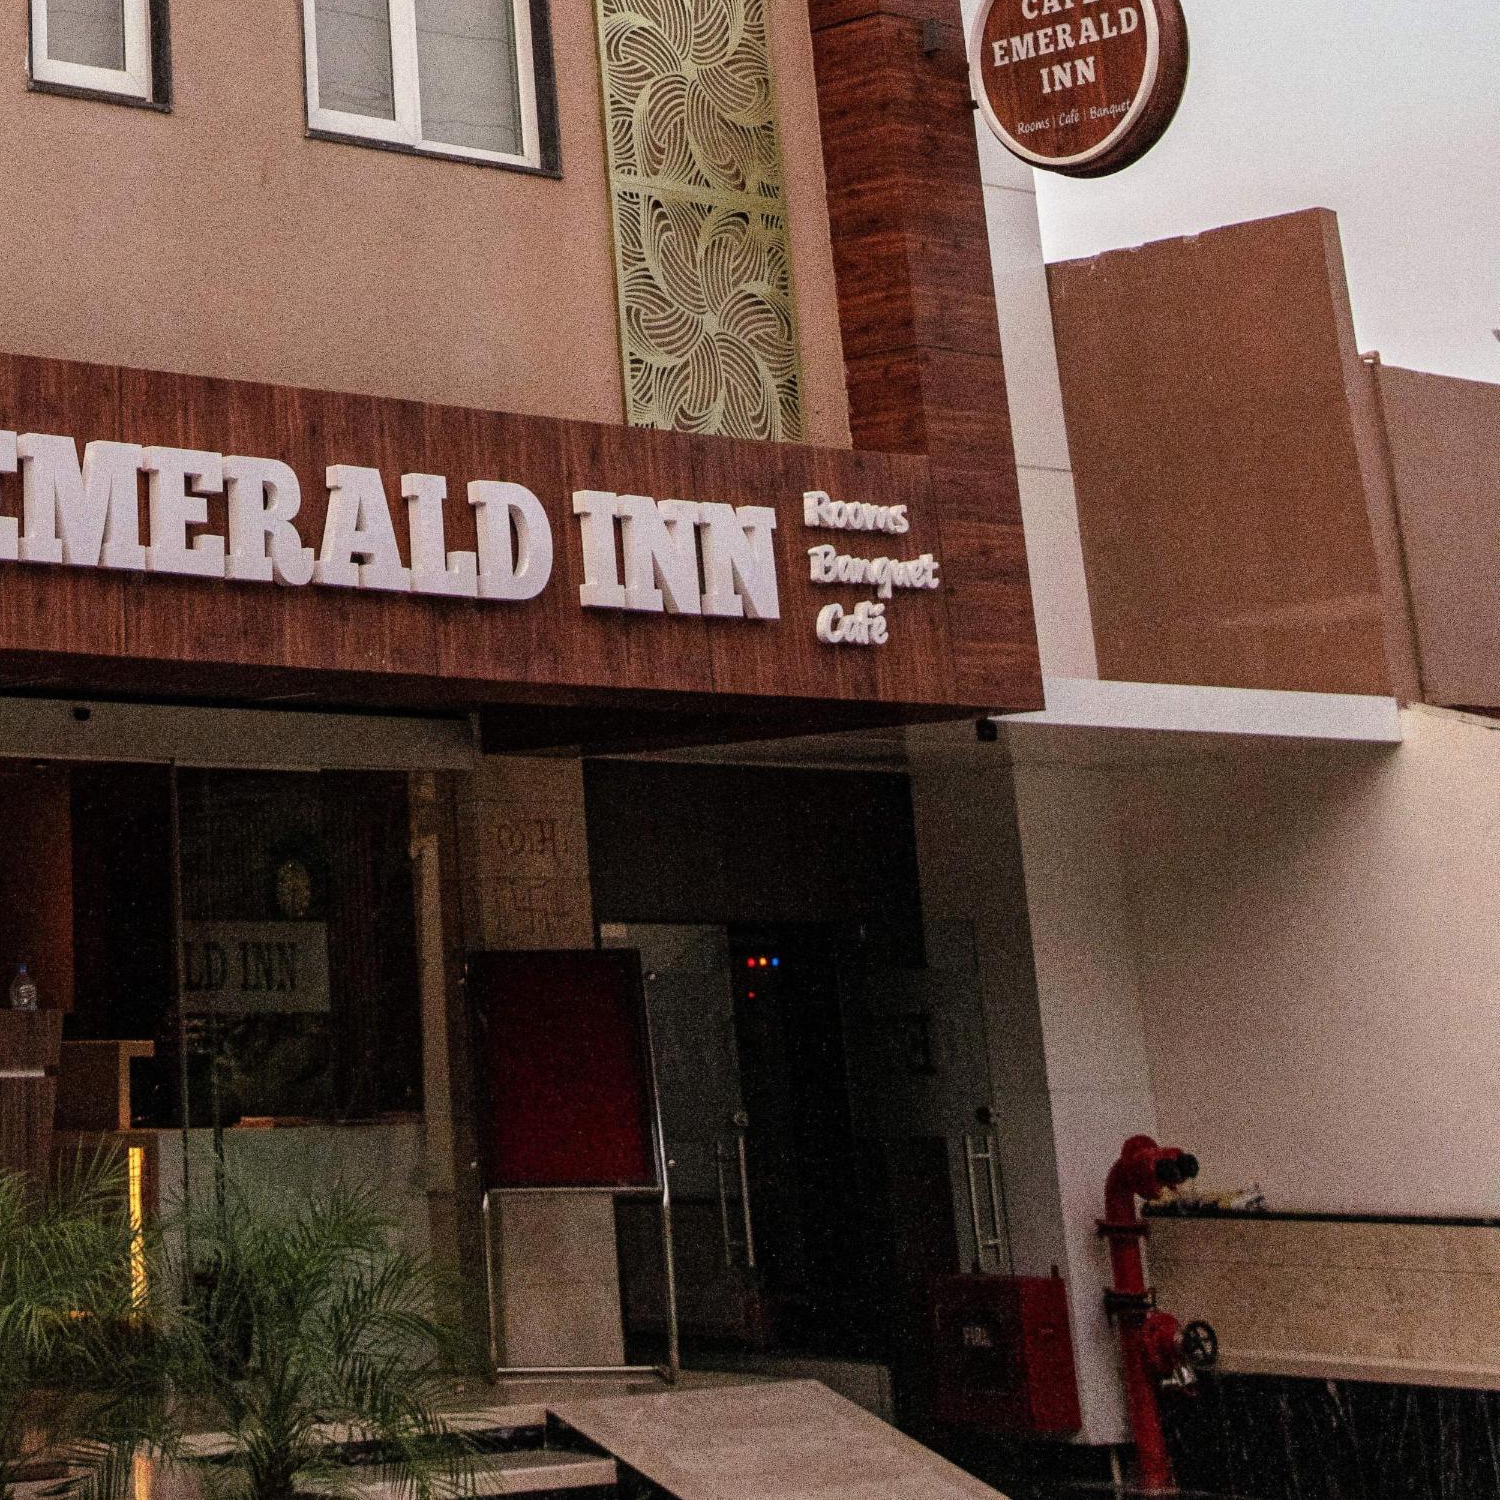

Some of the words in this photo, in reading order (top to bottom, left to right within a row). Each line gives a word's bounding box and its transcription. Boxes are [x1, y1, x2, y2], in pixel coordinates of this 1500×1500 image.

[991, 6, 1139, 67] EMERALD
[1039, 56, 1097, 94] INN
[1017, 116, 1051, 135] Rooms
[1058, 109, 1081, 127] Café
[1089, 99, 1132, 121] Banquet
[803, 490, 909, 533] Rooms
[572, 490, 781, 619] INN
[807, 544, 939, 599] Banquet
[816, 601, 888, 644] Café
